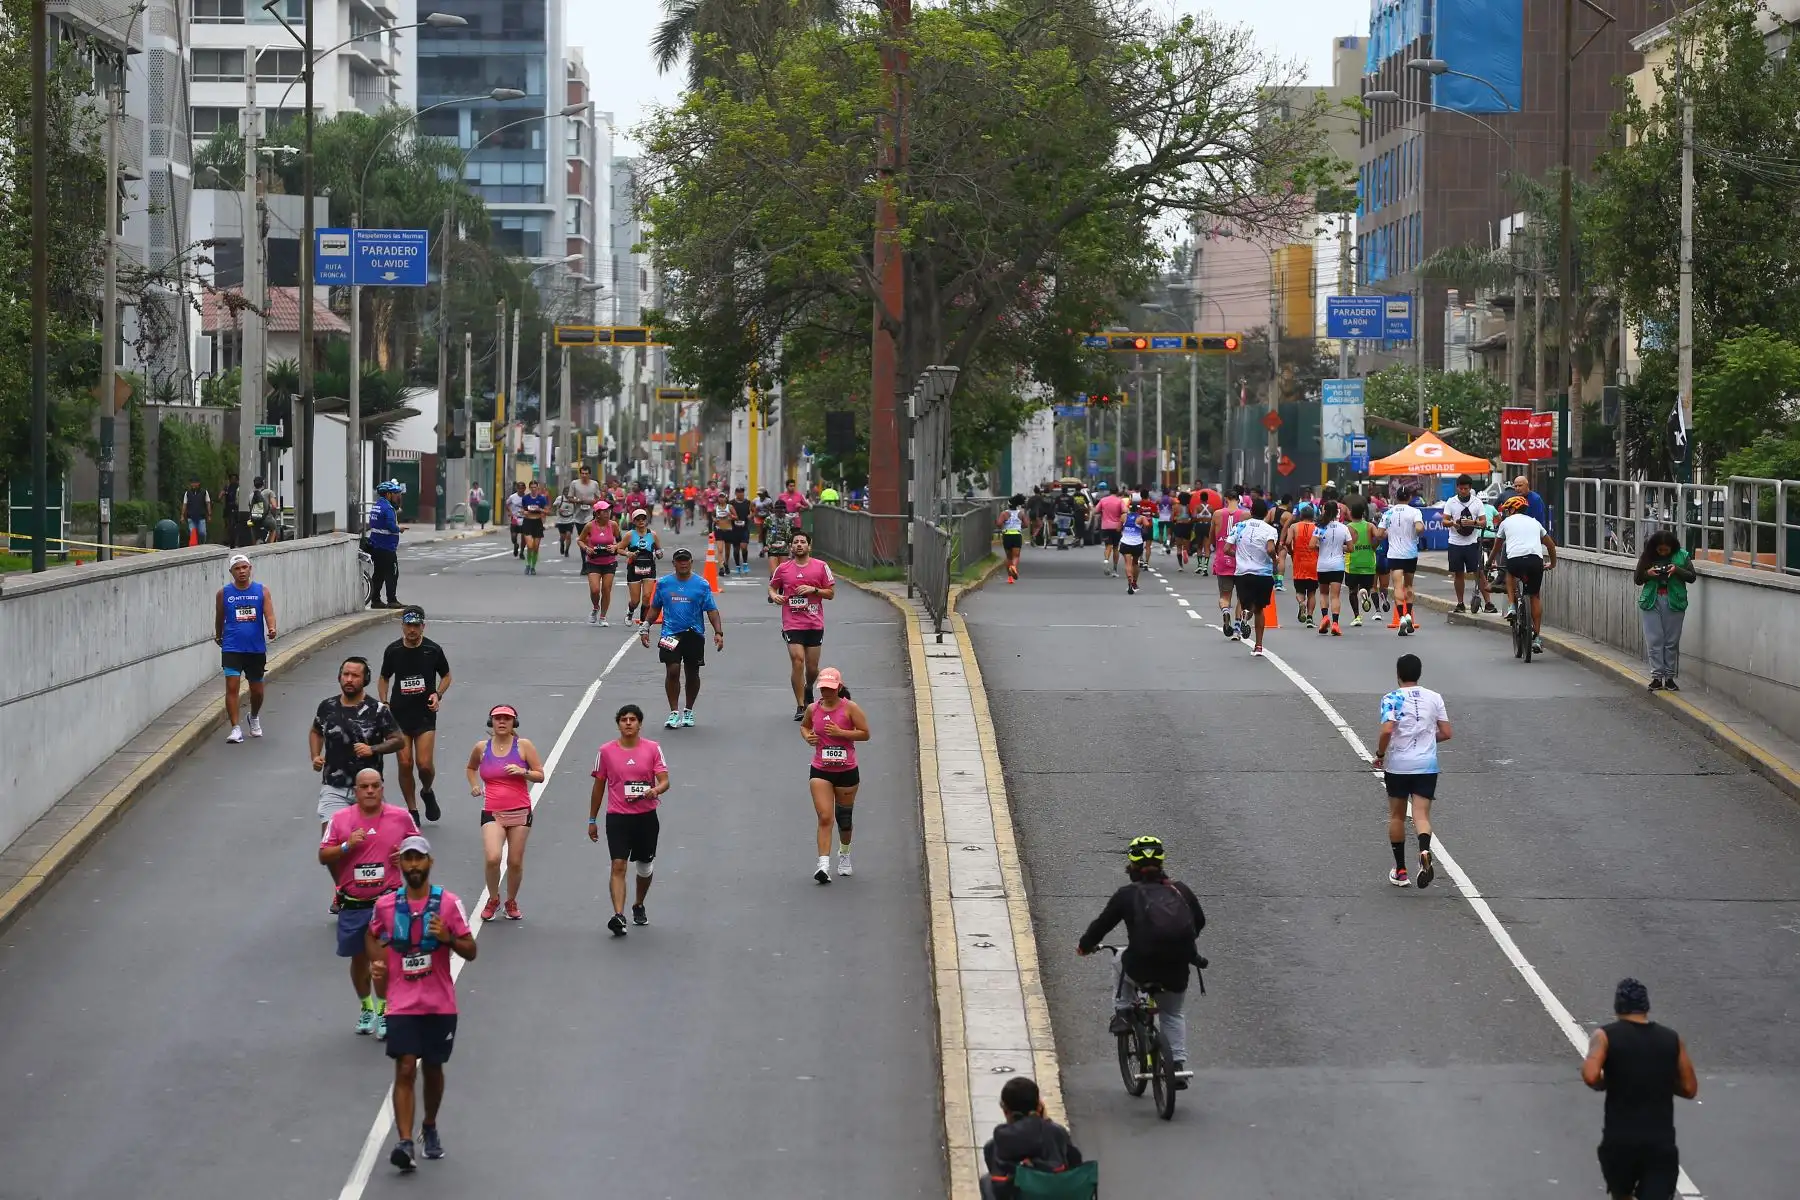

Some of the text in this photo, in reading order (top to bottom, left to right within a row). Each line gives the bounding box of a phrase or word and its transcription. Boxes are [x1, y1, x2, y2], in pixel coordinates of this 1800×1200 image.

[358, 231, 392, 240] Respetemos
[362, 245, 418, 256] PARADERO
[371, 259, 410, 268] OLAVIDE
[1333, 308, 1377, 317] PARADERO
[1343, 317, 1368, 326] BAÑÓN
[1323, 383, 1336, 391] Que
[1528, 437, 1550, 449] 33K
[1408, 463, 1455, 471] GATORADE
[361, 869, 377, 877] 106
